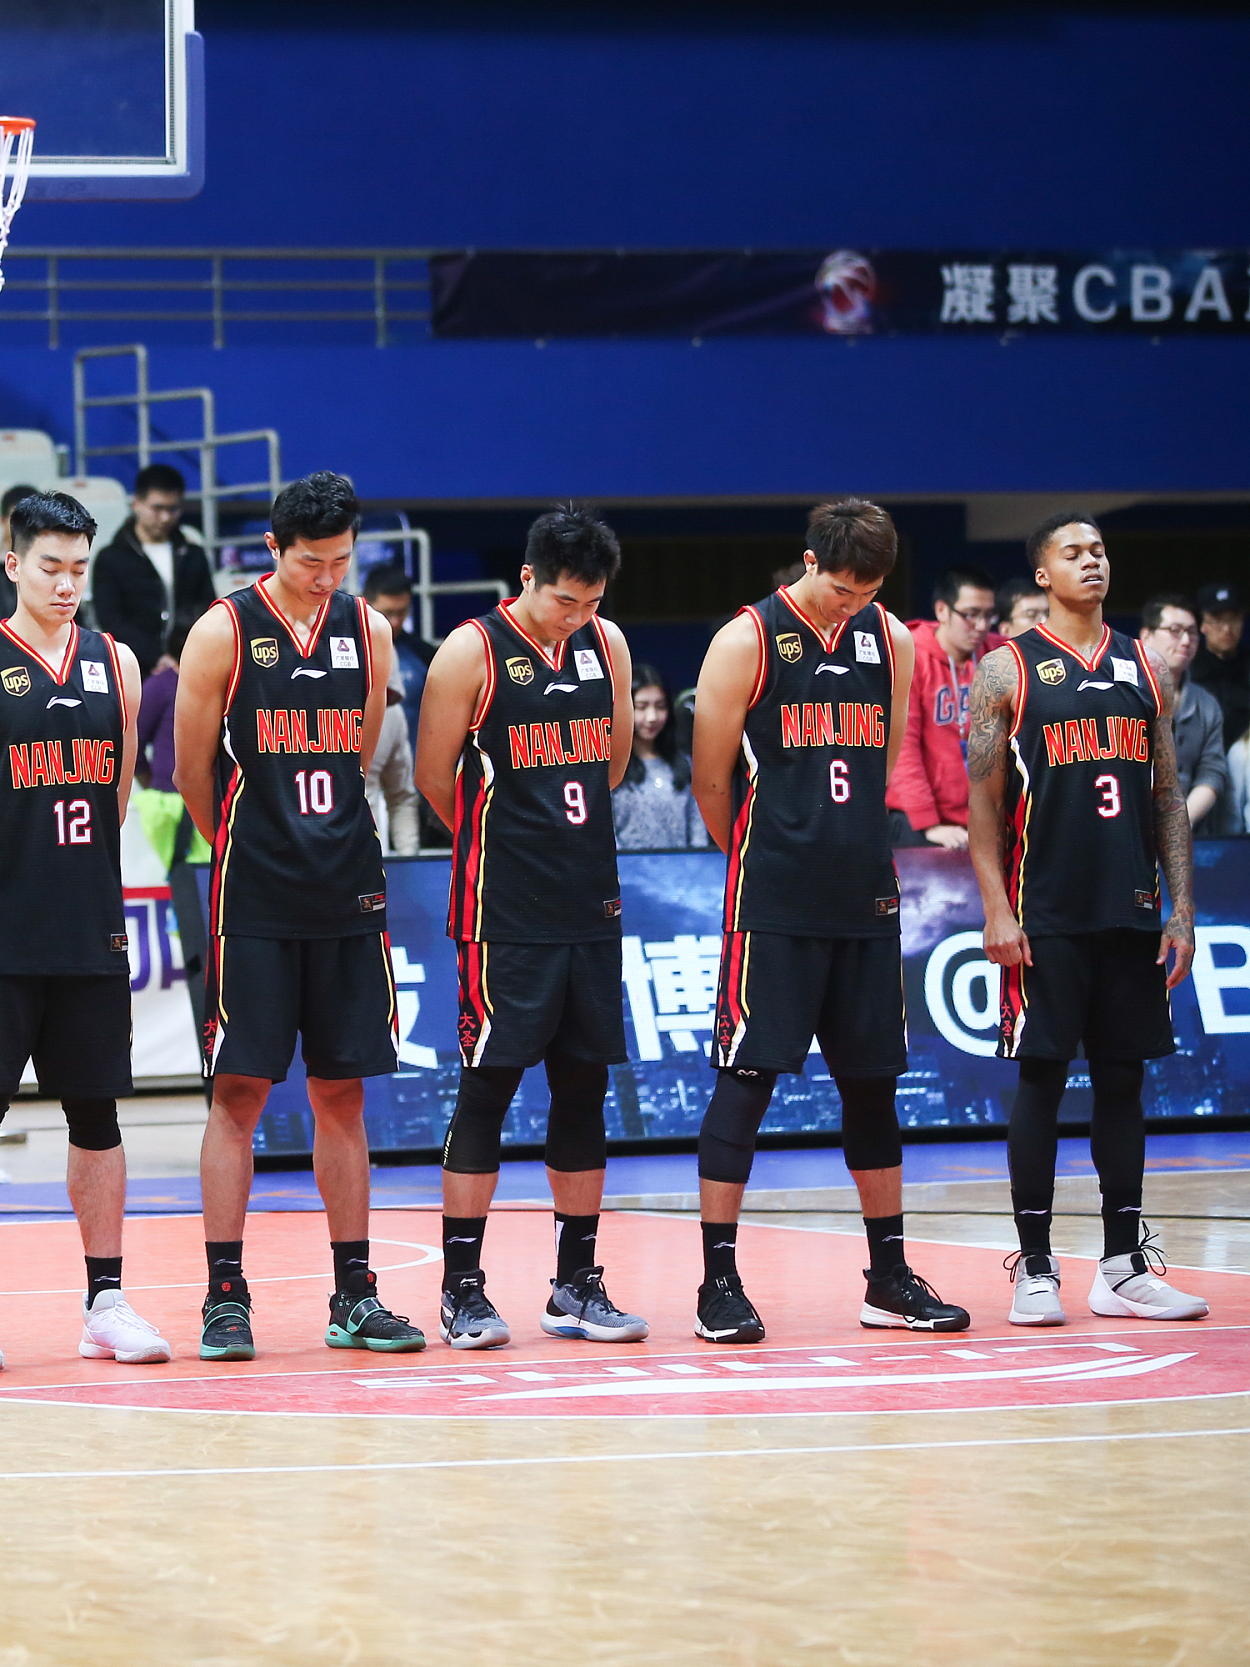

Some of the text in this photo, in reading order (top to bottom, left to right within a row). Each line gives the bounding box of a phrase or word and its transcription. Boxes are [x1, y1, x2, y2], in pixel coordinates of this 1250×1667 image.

[940, 262, 1250, 324] 凝聚CBA
[254, 646, 277, 664] ups
[509, 664, 532, 681] ups
[778, 641, 800, 659] ups
[5, 673, 28, 692] ups
[1040, 665, 1064, 682] ups
[256, 708, 363, 753] NANJING
[508, 717, 611, 770] NANJING
[780, 702, 885, 748] NANJING
[294, 769, 334, 814] 10
[562, 780, 588, 825] 9
[828, 759, 851, 804] 6
[1094, 774, 1122, 818] 3
[53, 799, 92, 845] 12
